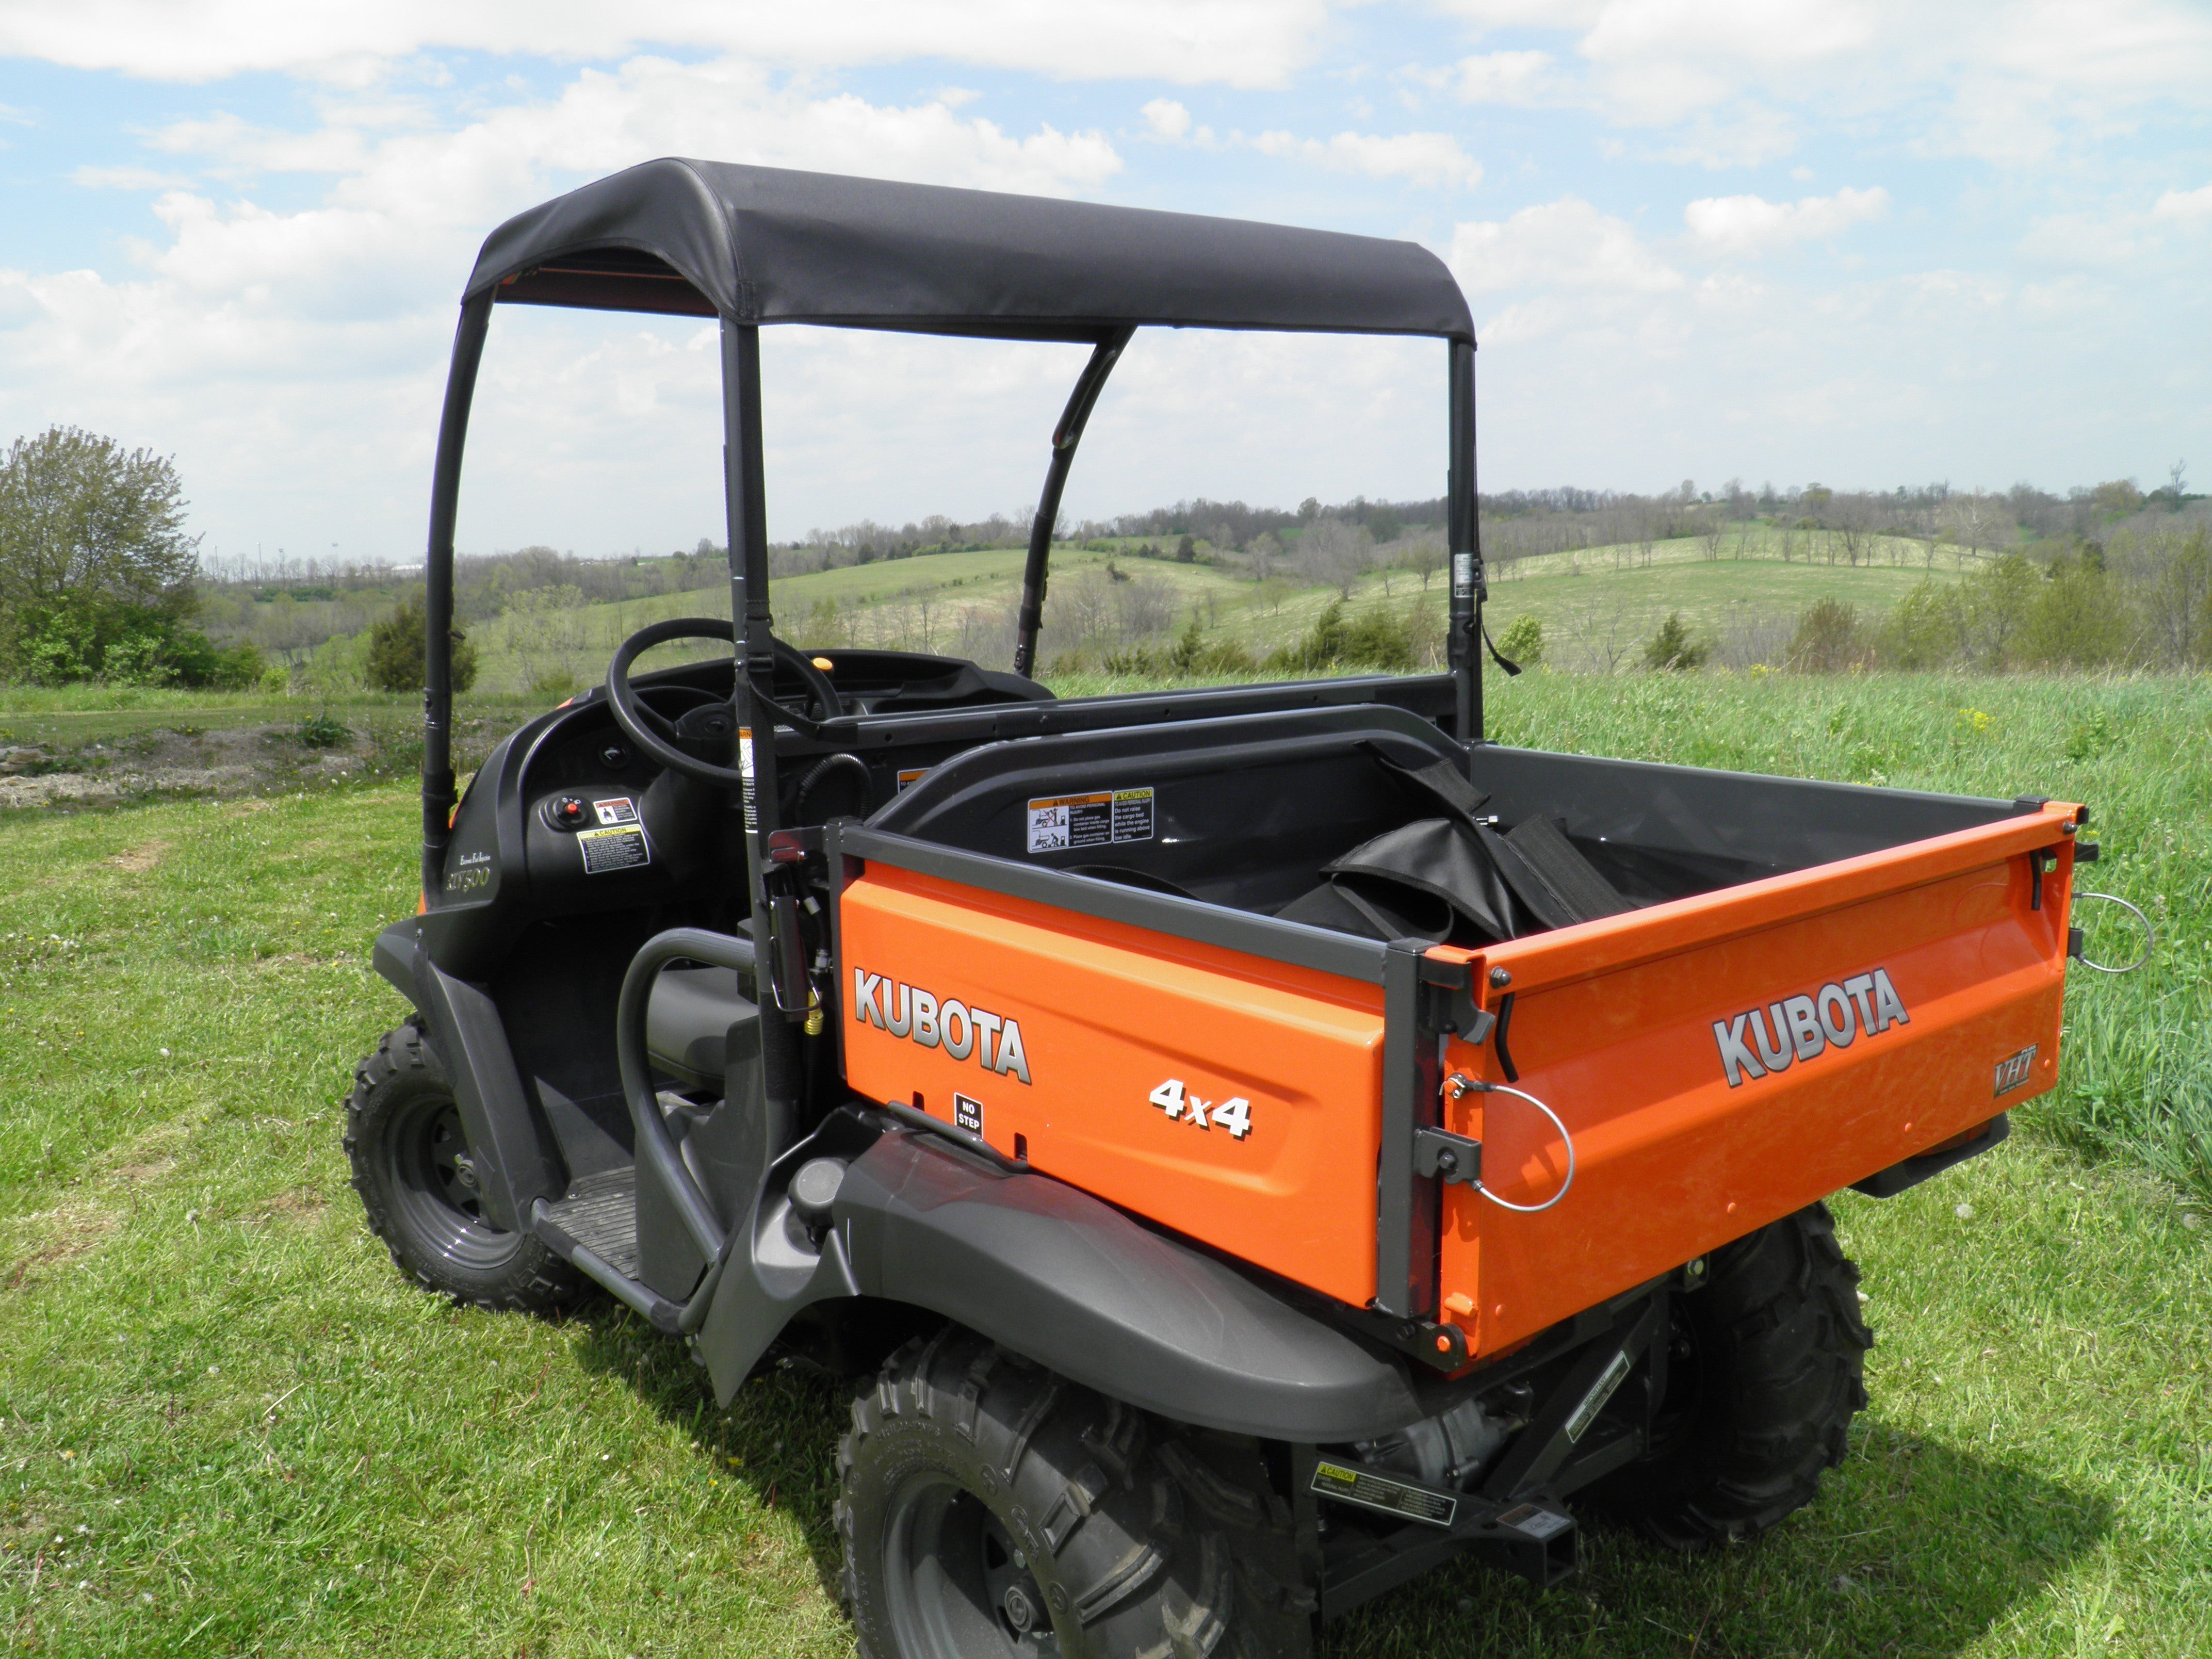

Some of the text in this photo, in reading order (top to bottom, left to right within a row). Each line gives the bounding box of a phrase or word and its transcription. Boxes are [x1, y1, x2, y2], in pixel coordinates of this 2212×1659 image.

[1059, 796, 1089, 805] WARNING
[1123, 790, 1150, 799] CAUTION
[600, 827, 627, 836] CAUTION
[854, 966, 1032, 1086] KUBOTA
[1712, 967, 1910, 1088] KUBOTA
[1994, 1047, 2037, 1097] VHT
[963, 1101, 975, 1115] NO
[1149, 1078, 1252, 1139] 4x4
[958, 1113, 980, 1130] STEP
[1327, 1467, 1353, 1480] CAUTION
